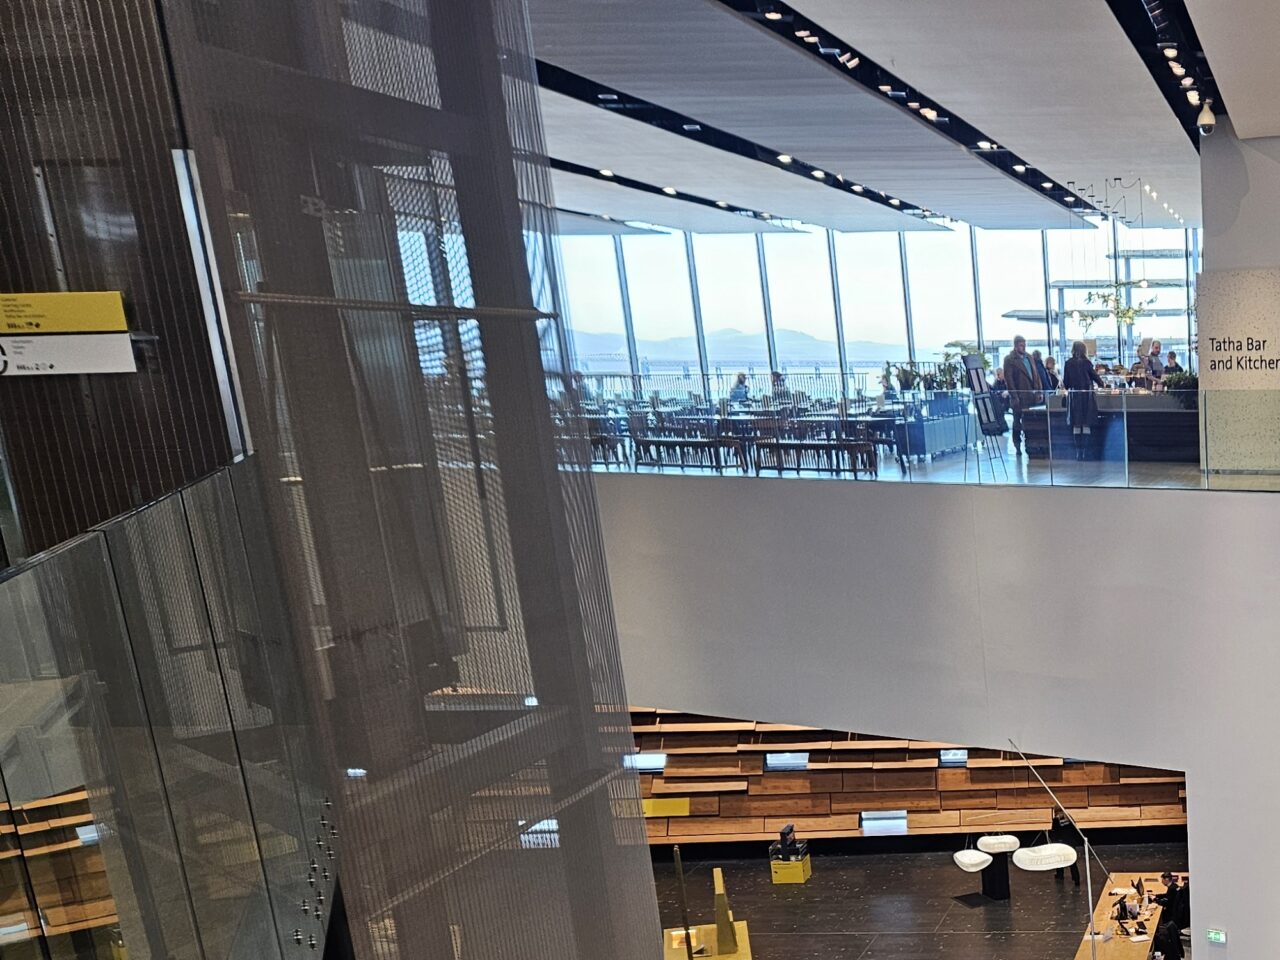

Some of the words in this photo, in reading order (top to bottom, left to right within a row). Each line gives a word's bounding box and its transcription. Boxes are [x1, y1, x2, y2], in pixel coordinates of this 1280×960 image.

[1209, 336, 1243, 352] Tatha
[1246, 336, 1267, 351] Bar
[1210, 355, 1233, 370] and
